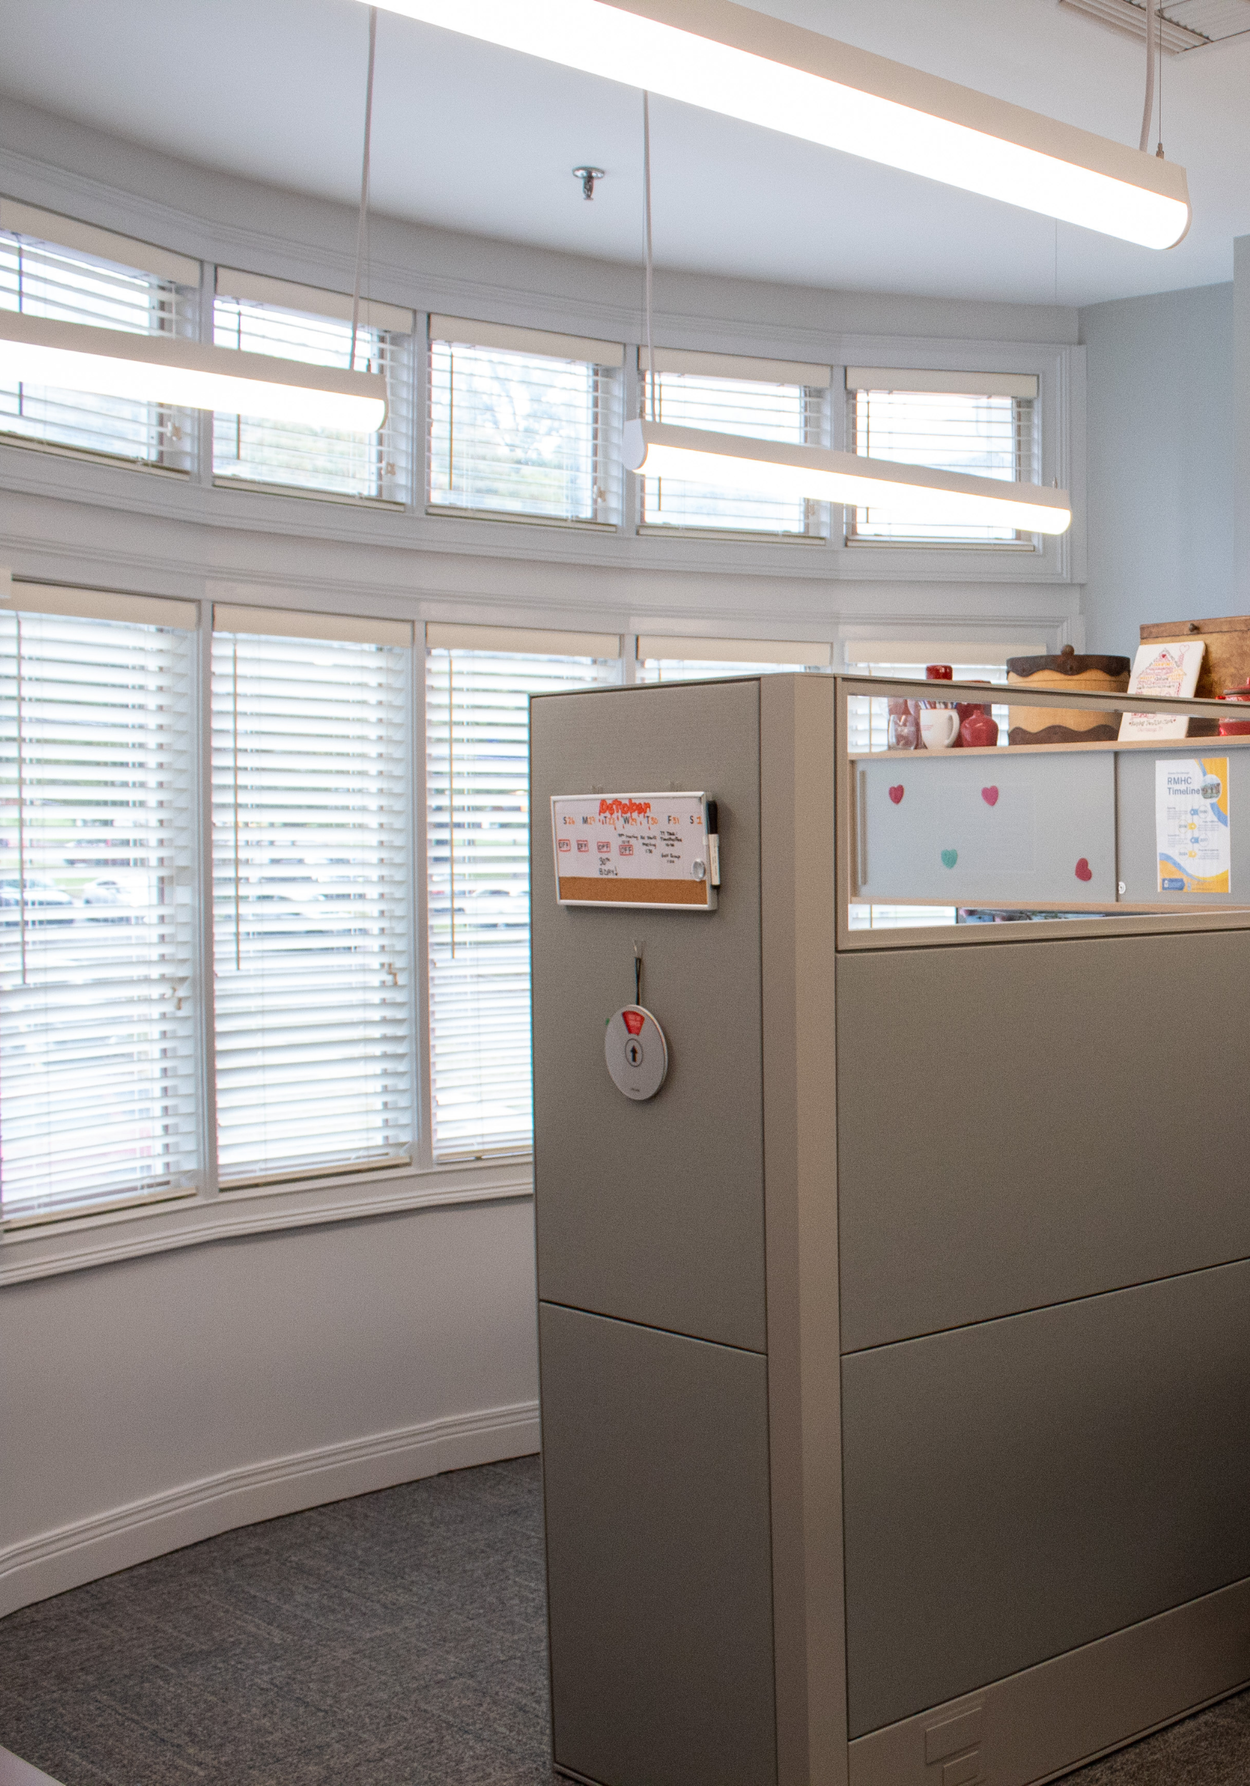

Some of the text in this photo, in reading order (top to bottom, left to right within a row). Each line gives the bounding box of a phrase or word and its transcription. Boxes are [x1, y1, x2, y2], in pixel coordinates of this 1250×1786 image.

[1167, 776, 1192, 785] RMHC
[1167, 786, 1201, 795] Timeline
[599, 798, 651, 817] October
